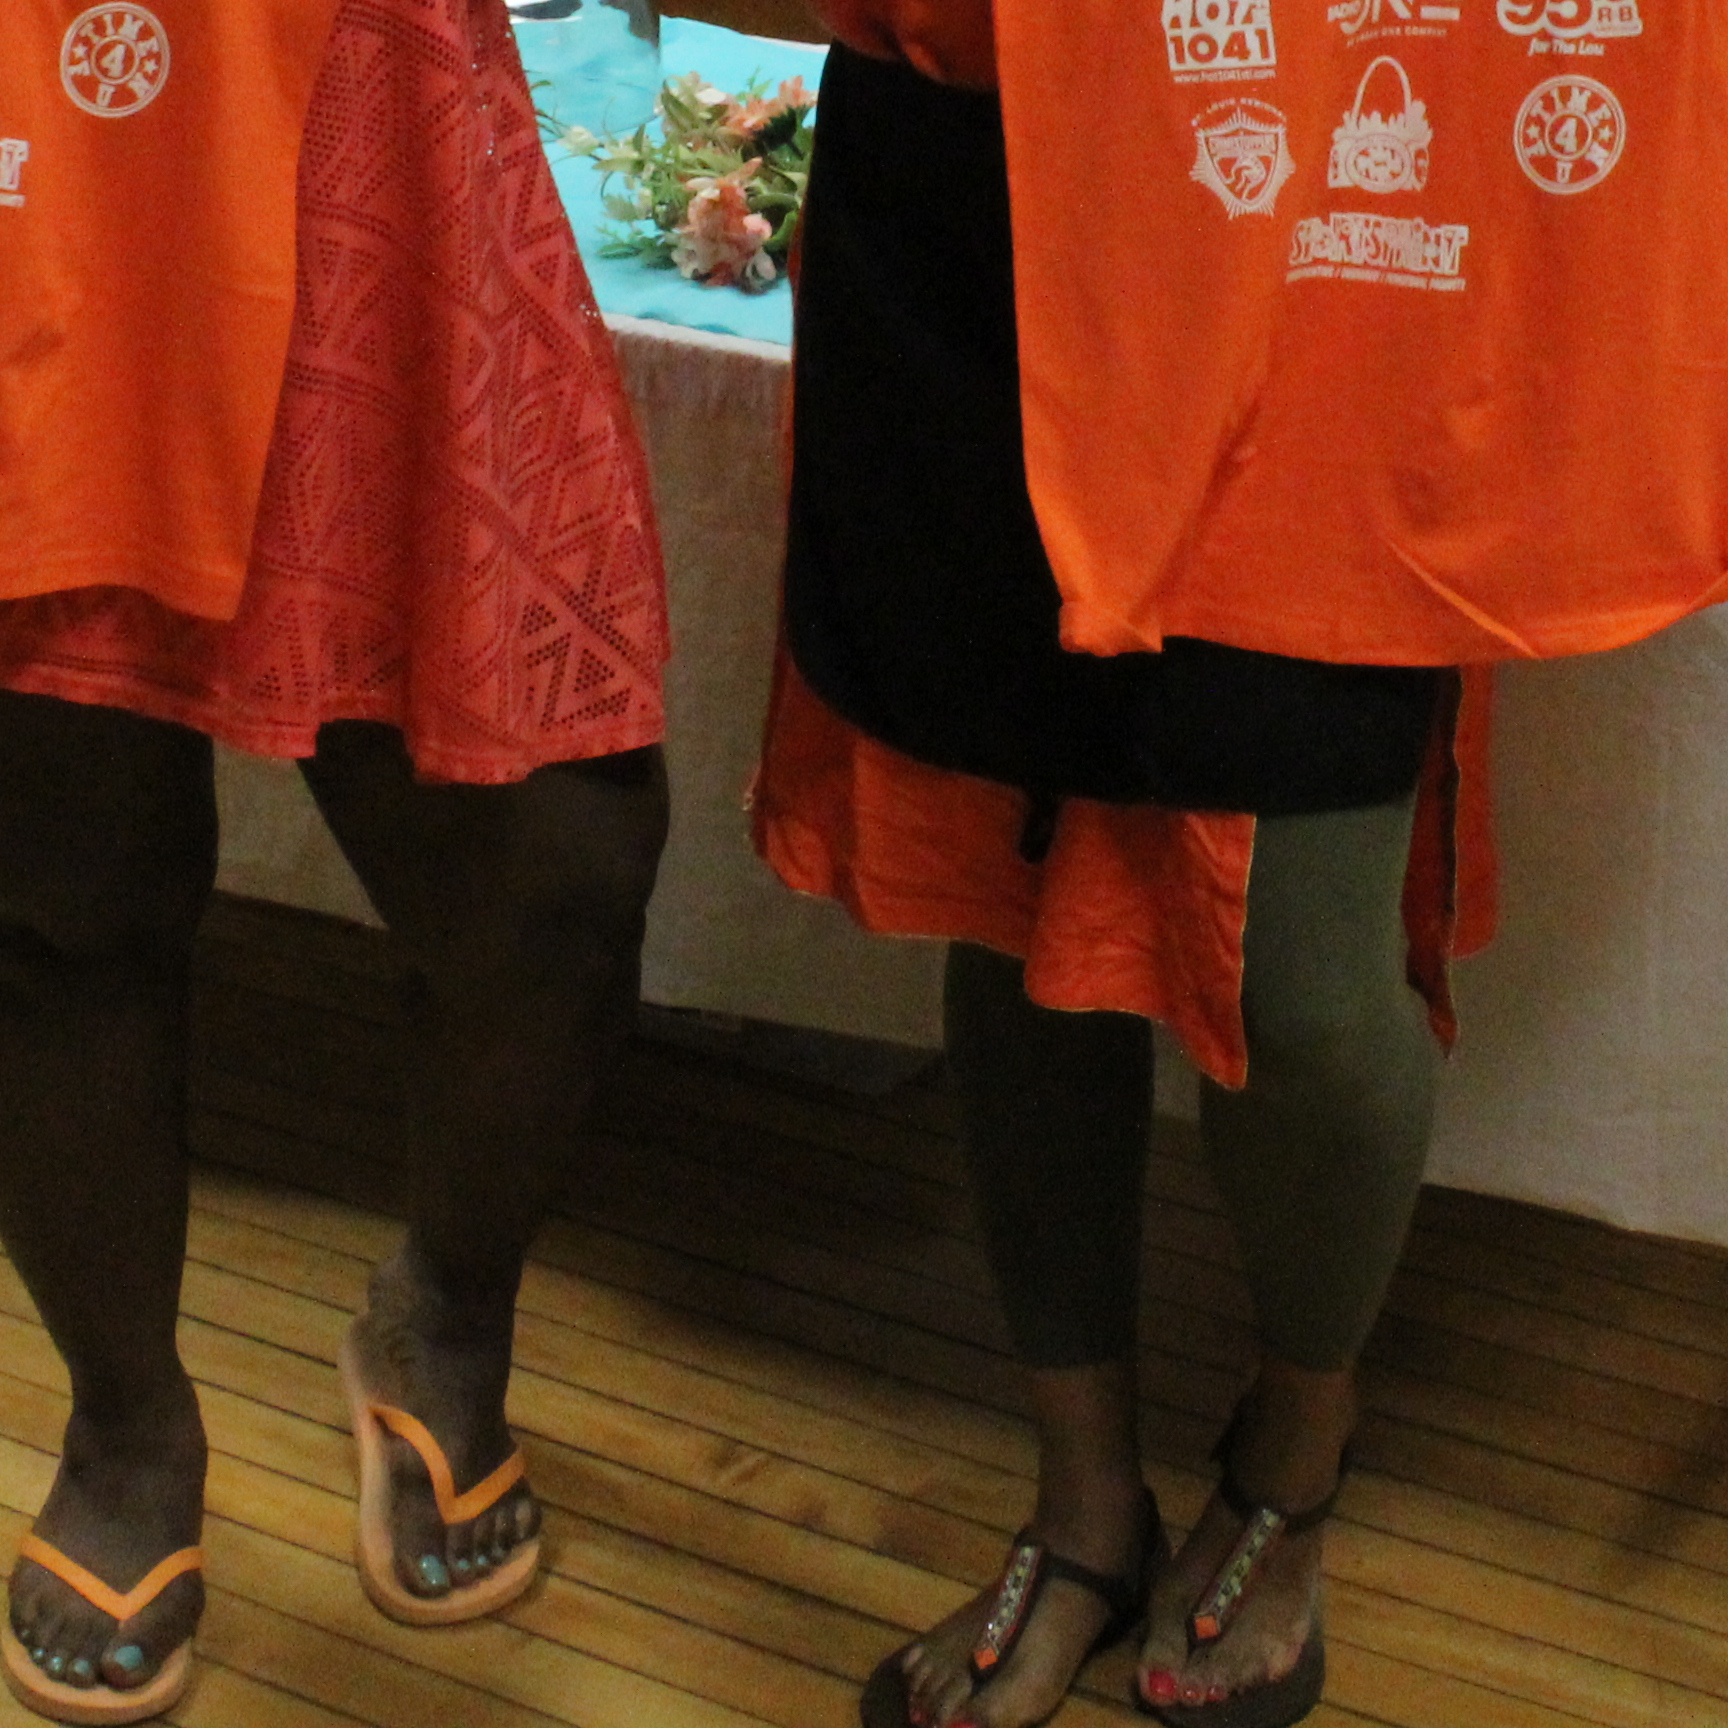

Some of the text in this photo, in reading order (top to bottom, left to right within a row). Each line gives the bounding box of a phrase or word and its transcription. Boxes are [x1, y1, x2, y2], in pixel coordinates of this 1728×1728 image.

[100, 43, 127, 78] 4
[1169, 27, 1272, 65] 1041
[1554, 117, 1579, 154] 4
